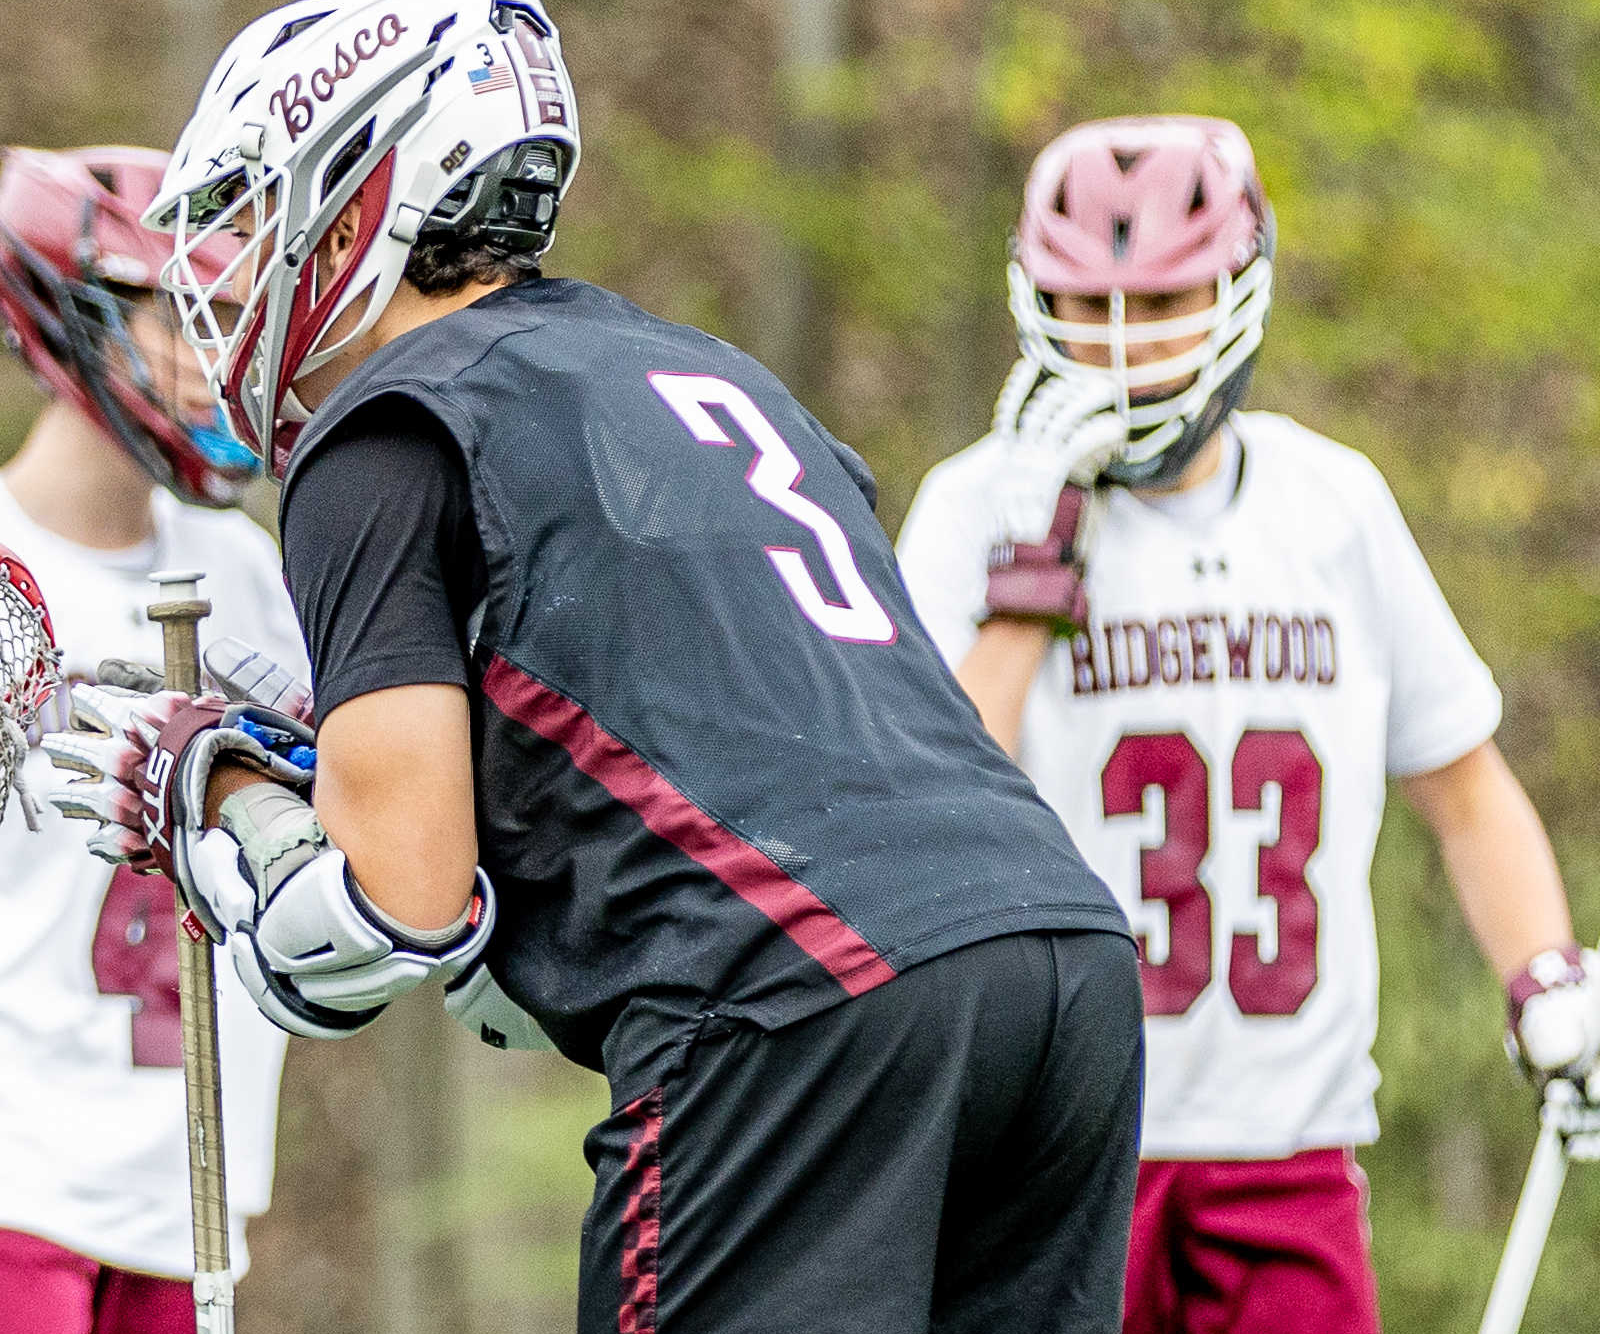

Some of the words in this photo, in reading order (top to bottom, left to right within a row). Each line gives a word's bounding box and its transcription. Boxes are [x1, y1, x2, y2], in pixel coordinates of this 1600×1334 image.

[270, 13, 408, 143] Bosco
[476, 42, 495, 66] 3
[647, 370, 898, 645] 3
[1071, 610, 1338, 694] RIDGEWOOD
[143, 746, 176, 852] STX
[1101, 729, 1324, 1016] 33
